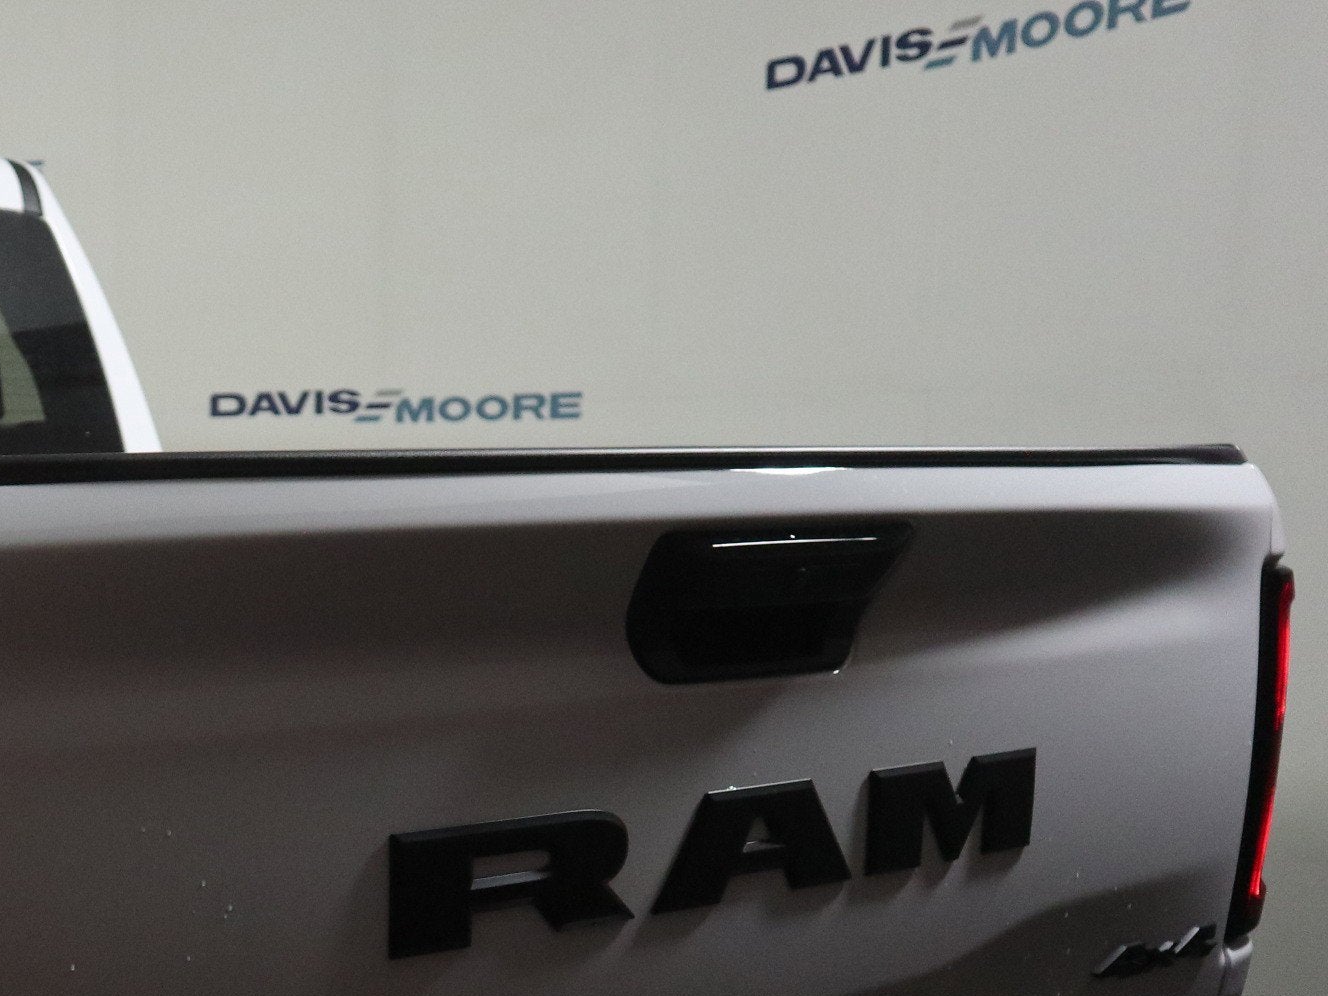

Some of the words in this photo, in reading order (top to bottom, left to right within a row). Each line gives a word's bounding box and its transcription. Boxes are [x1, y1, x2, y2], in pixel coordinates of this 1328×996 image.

[765, 28, 933, 90] DAVIS
[210, 389, 361, 417] DAVIS
[394, 392, 583, 423] MOORE
[389, 747, 1037, 960] RAM
